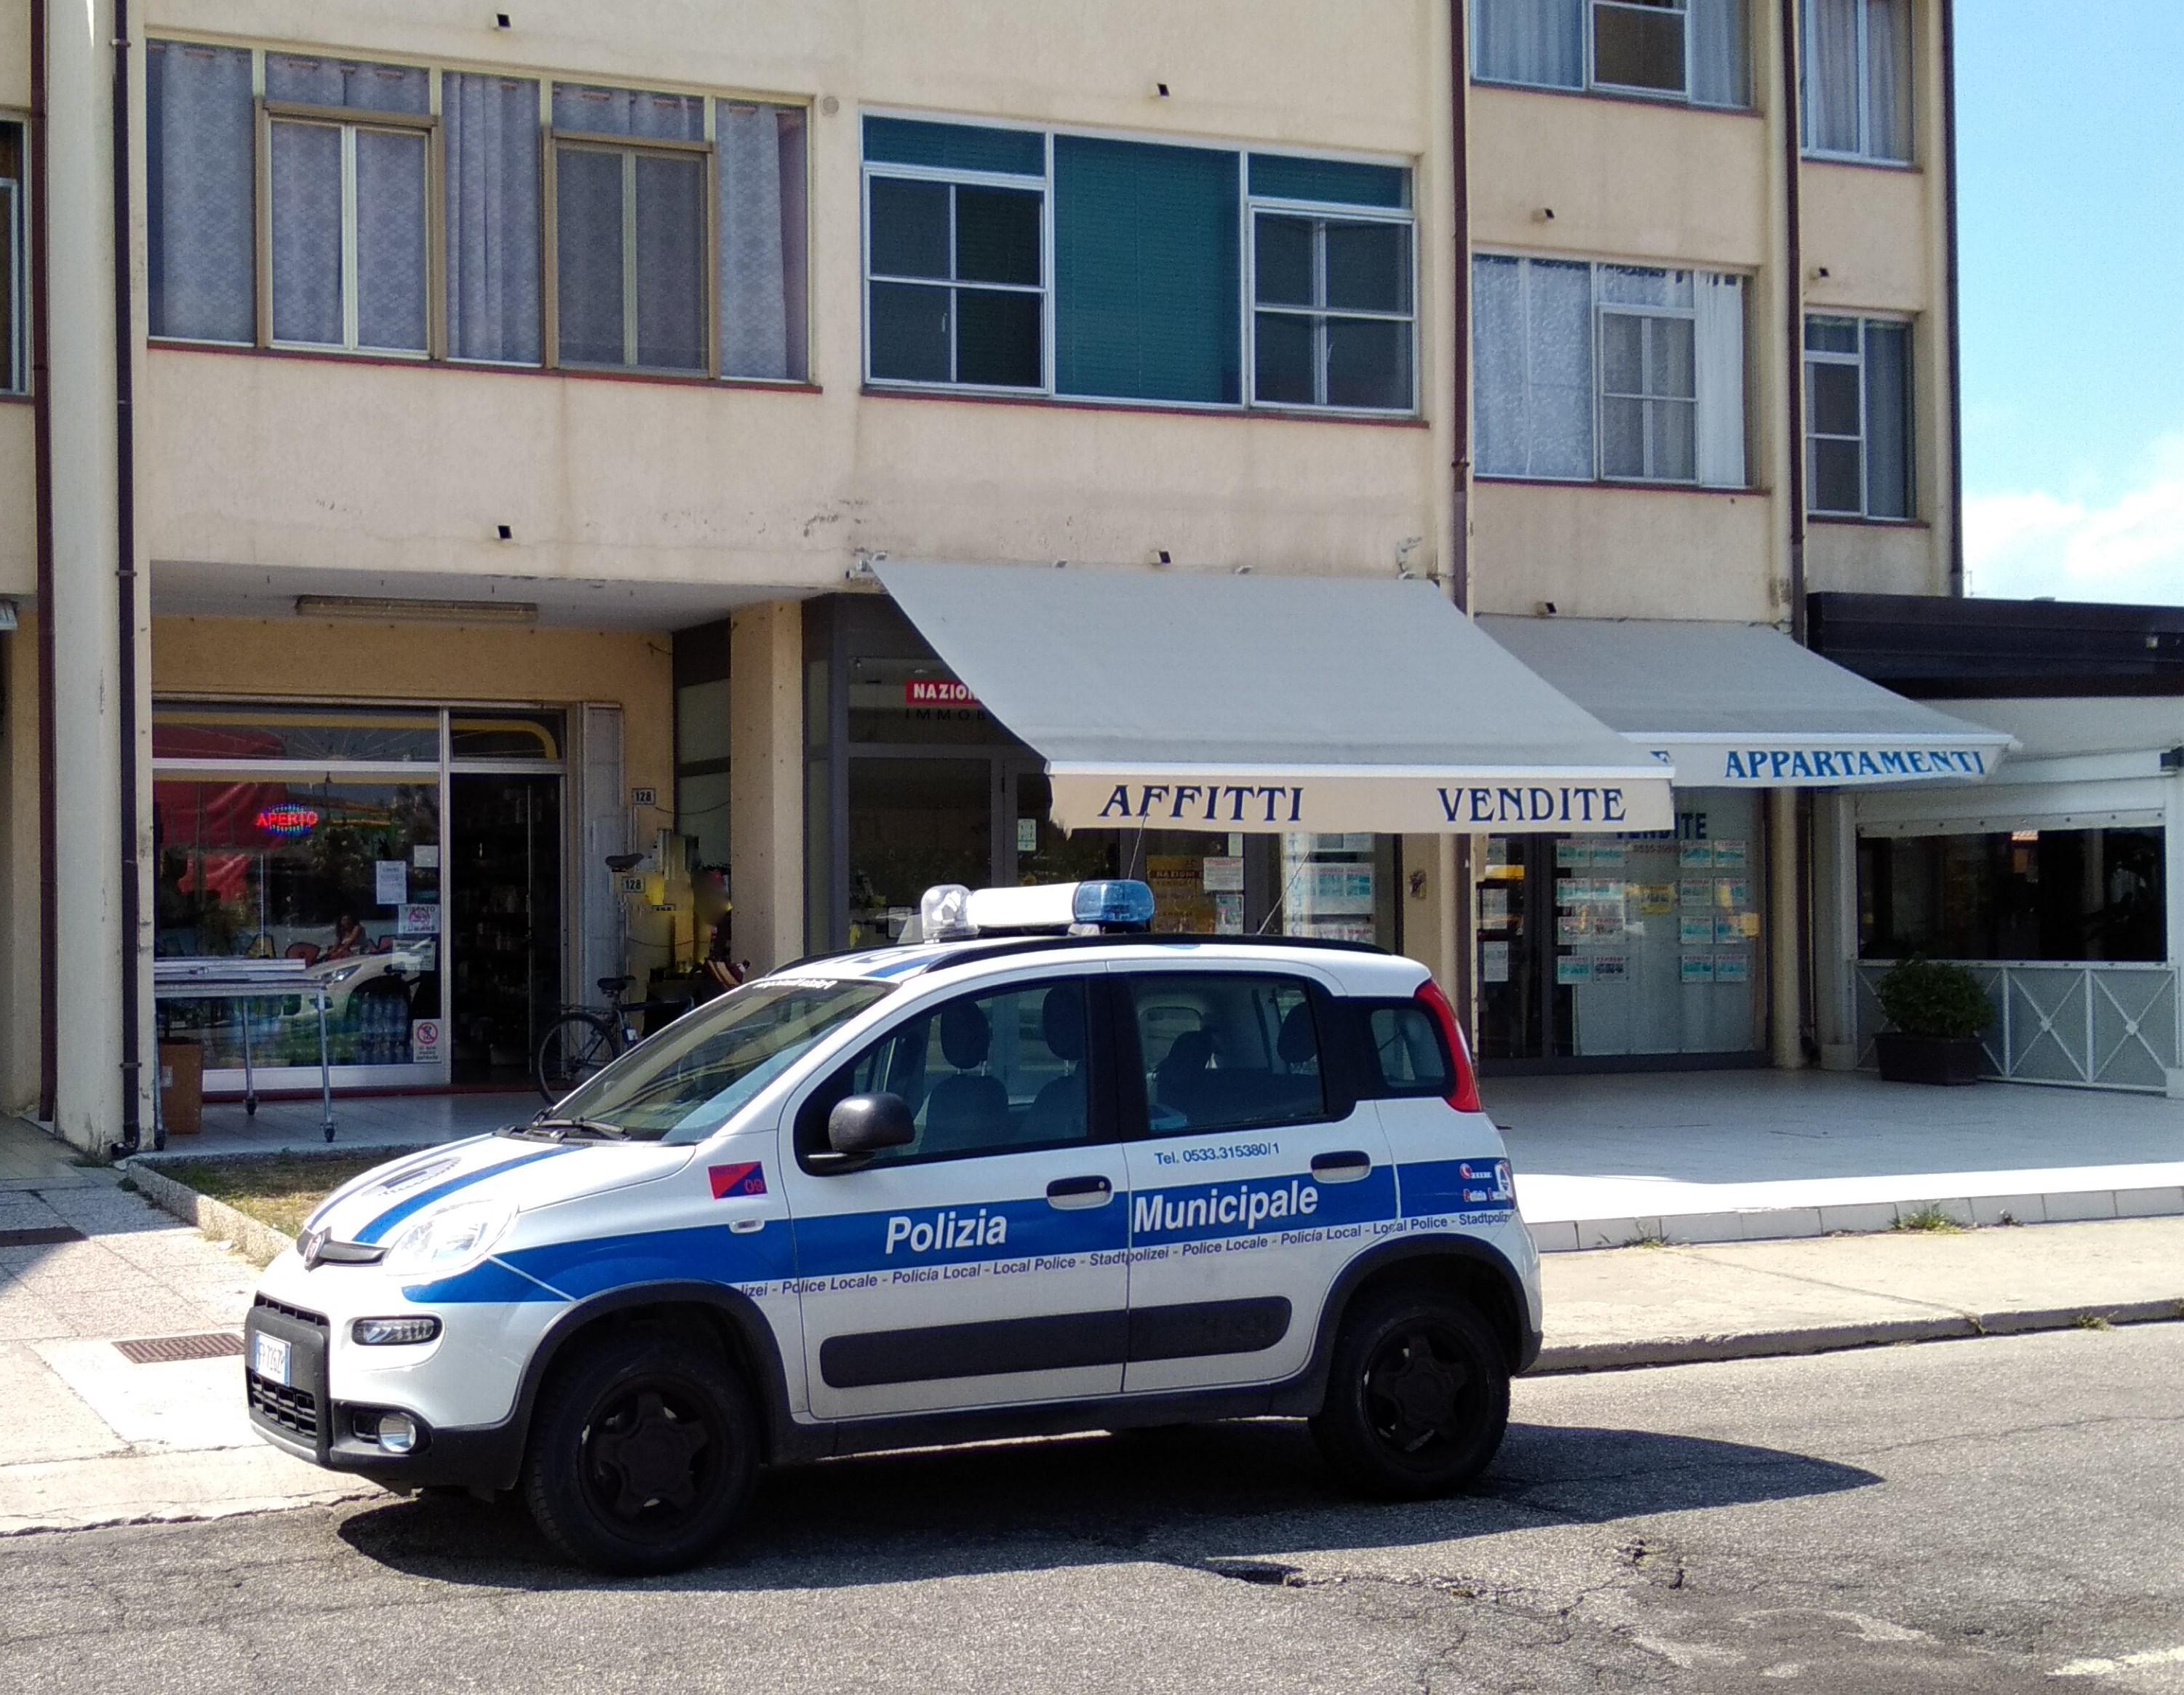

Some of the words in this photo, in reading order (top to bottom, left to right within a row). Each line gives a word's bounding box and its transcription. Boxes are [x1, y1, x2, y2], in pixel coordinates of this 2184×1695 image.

[1724, 750, 1985, 778] APPARTAMENTI
[635, 791, 652, 802] 128
[1097, 784, 1304, 822] AFFITTI
[1436, 786, 1627, 822] VENDITE
[255, 811, 319, 827] APERTO
[625, 879, 642, 890] 128
[1154, 1152, 1180, 1165] Tel.
[1182, 1142, 1280, 1163] 0533.315380/1
[885, 1208, 1007, 1255] Polizia
[1133, 1179, 1319, 1233] Municipale
[740, 1283, 768, 1297] lizei
[782, 1280, 826, 1295] Police
[830, 1275, 878, 1291] Locale
[892, 1267, 939, 1284] Policía
[943, 1264, 981, 1280] Local
[993, 1259, 1030, 1275] Local
[1035, 1257, 1076, 1272] Police
[1089, 1246, 1169, 1267] Stadtpolizei
[1181, 1241, 1222, 1256] Police
[1226, 1236, 1268, 1251] Locale
[1280, 1229, 1323, 1245] Policía
[1326, 1225, 1361, 1240] Local
[1373, 1220, 1407, 1235] Local
[1411, 1216, 1448, 1231] Police
